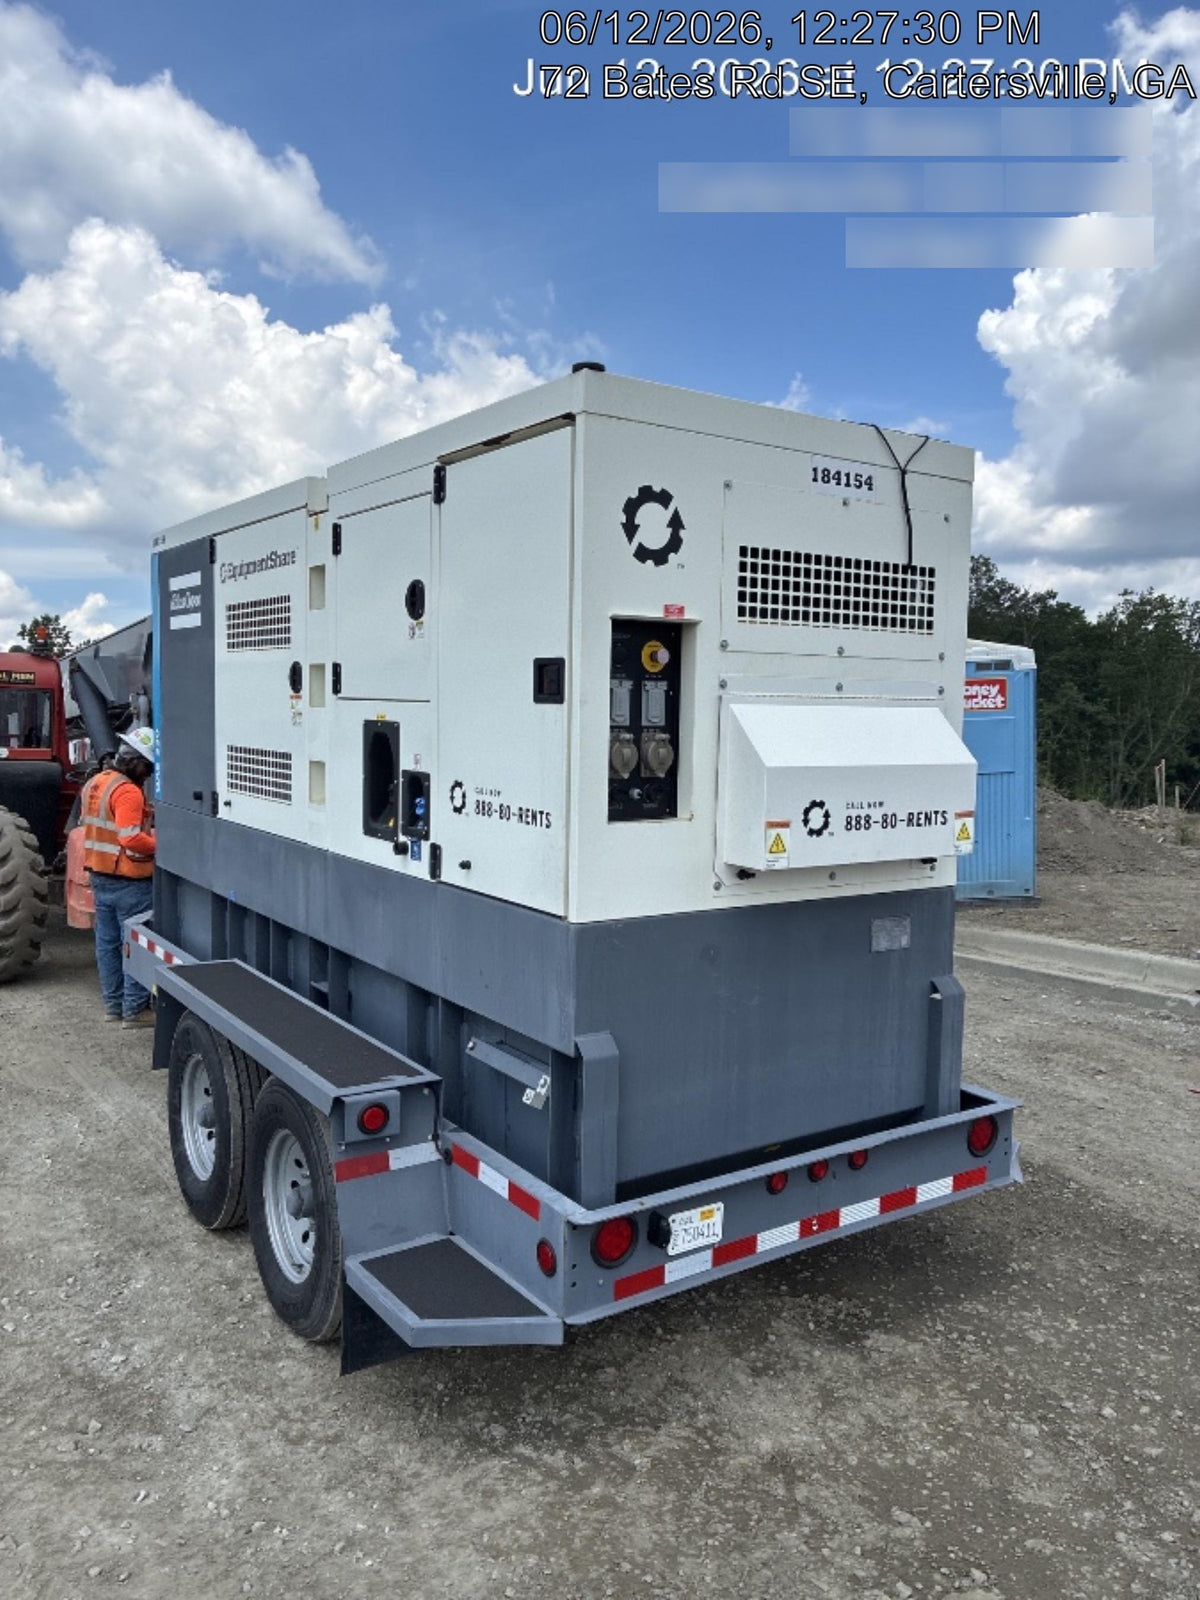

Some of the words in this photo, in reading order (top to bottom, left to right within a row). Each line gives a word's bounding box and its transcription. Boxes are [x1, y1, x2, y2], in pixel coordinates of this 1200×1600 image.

[811, 466, 874, 491] 184154
[963, 684, 1000, 699] oney
[963, 694, 1006, 709] ucket
[474, 799, 552, 829] 888-80-RENTS
[845, 810, 949, 832] 888-80-RENTS
